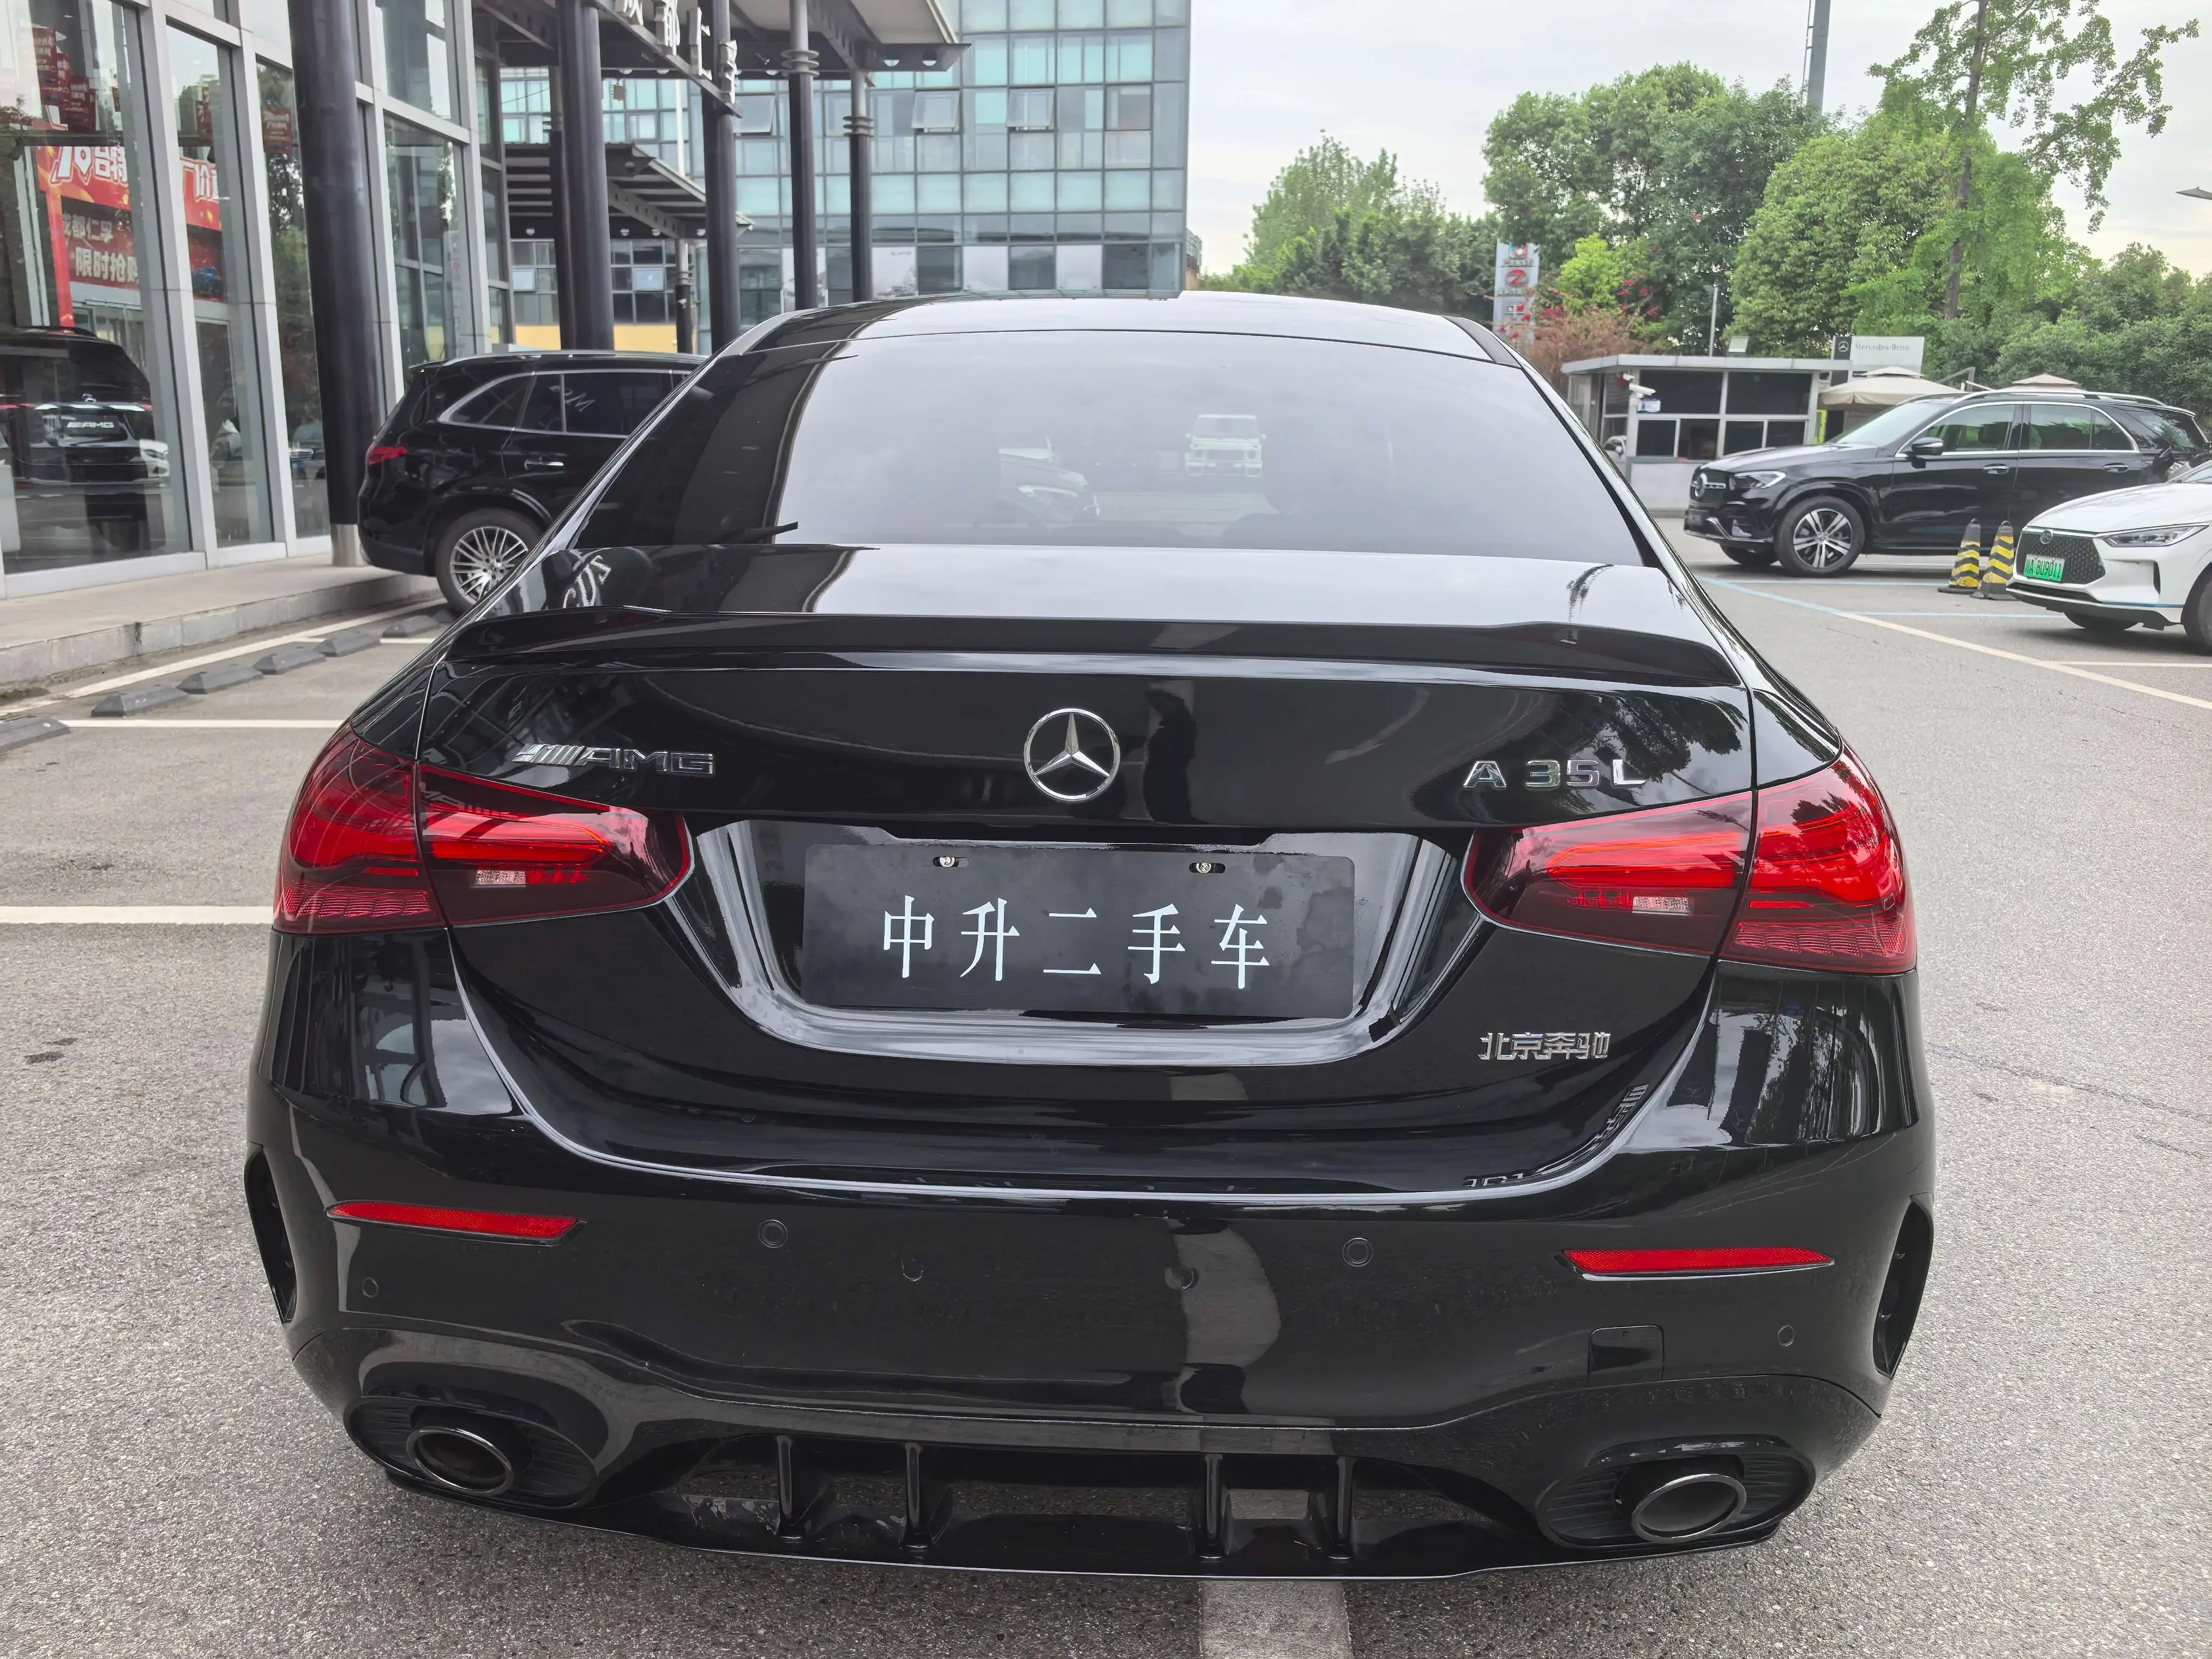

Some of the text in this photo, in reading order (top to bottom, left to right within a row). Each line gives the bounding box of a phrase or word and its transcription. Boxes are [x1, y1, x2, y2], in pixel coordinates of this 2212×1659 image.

[1855, 342, 1909, 351] Mercedes-Benz
[1462, 759, 1507, 788] A
[884, 895, 1270, 989] 中升二手车
[1478, 1032, 1611, 1060] 北京奔驰
